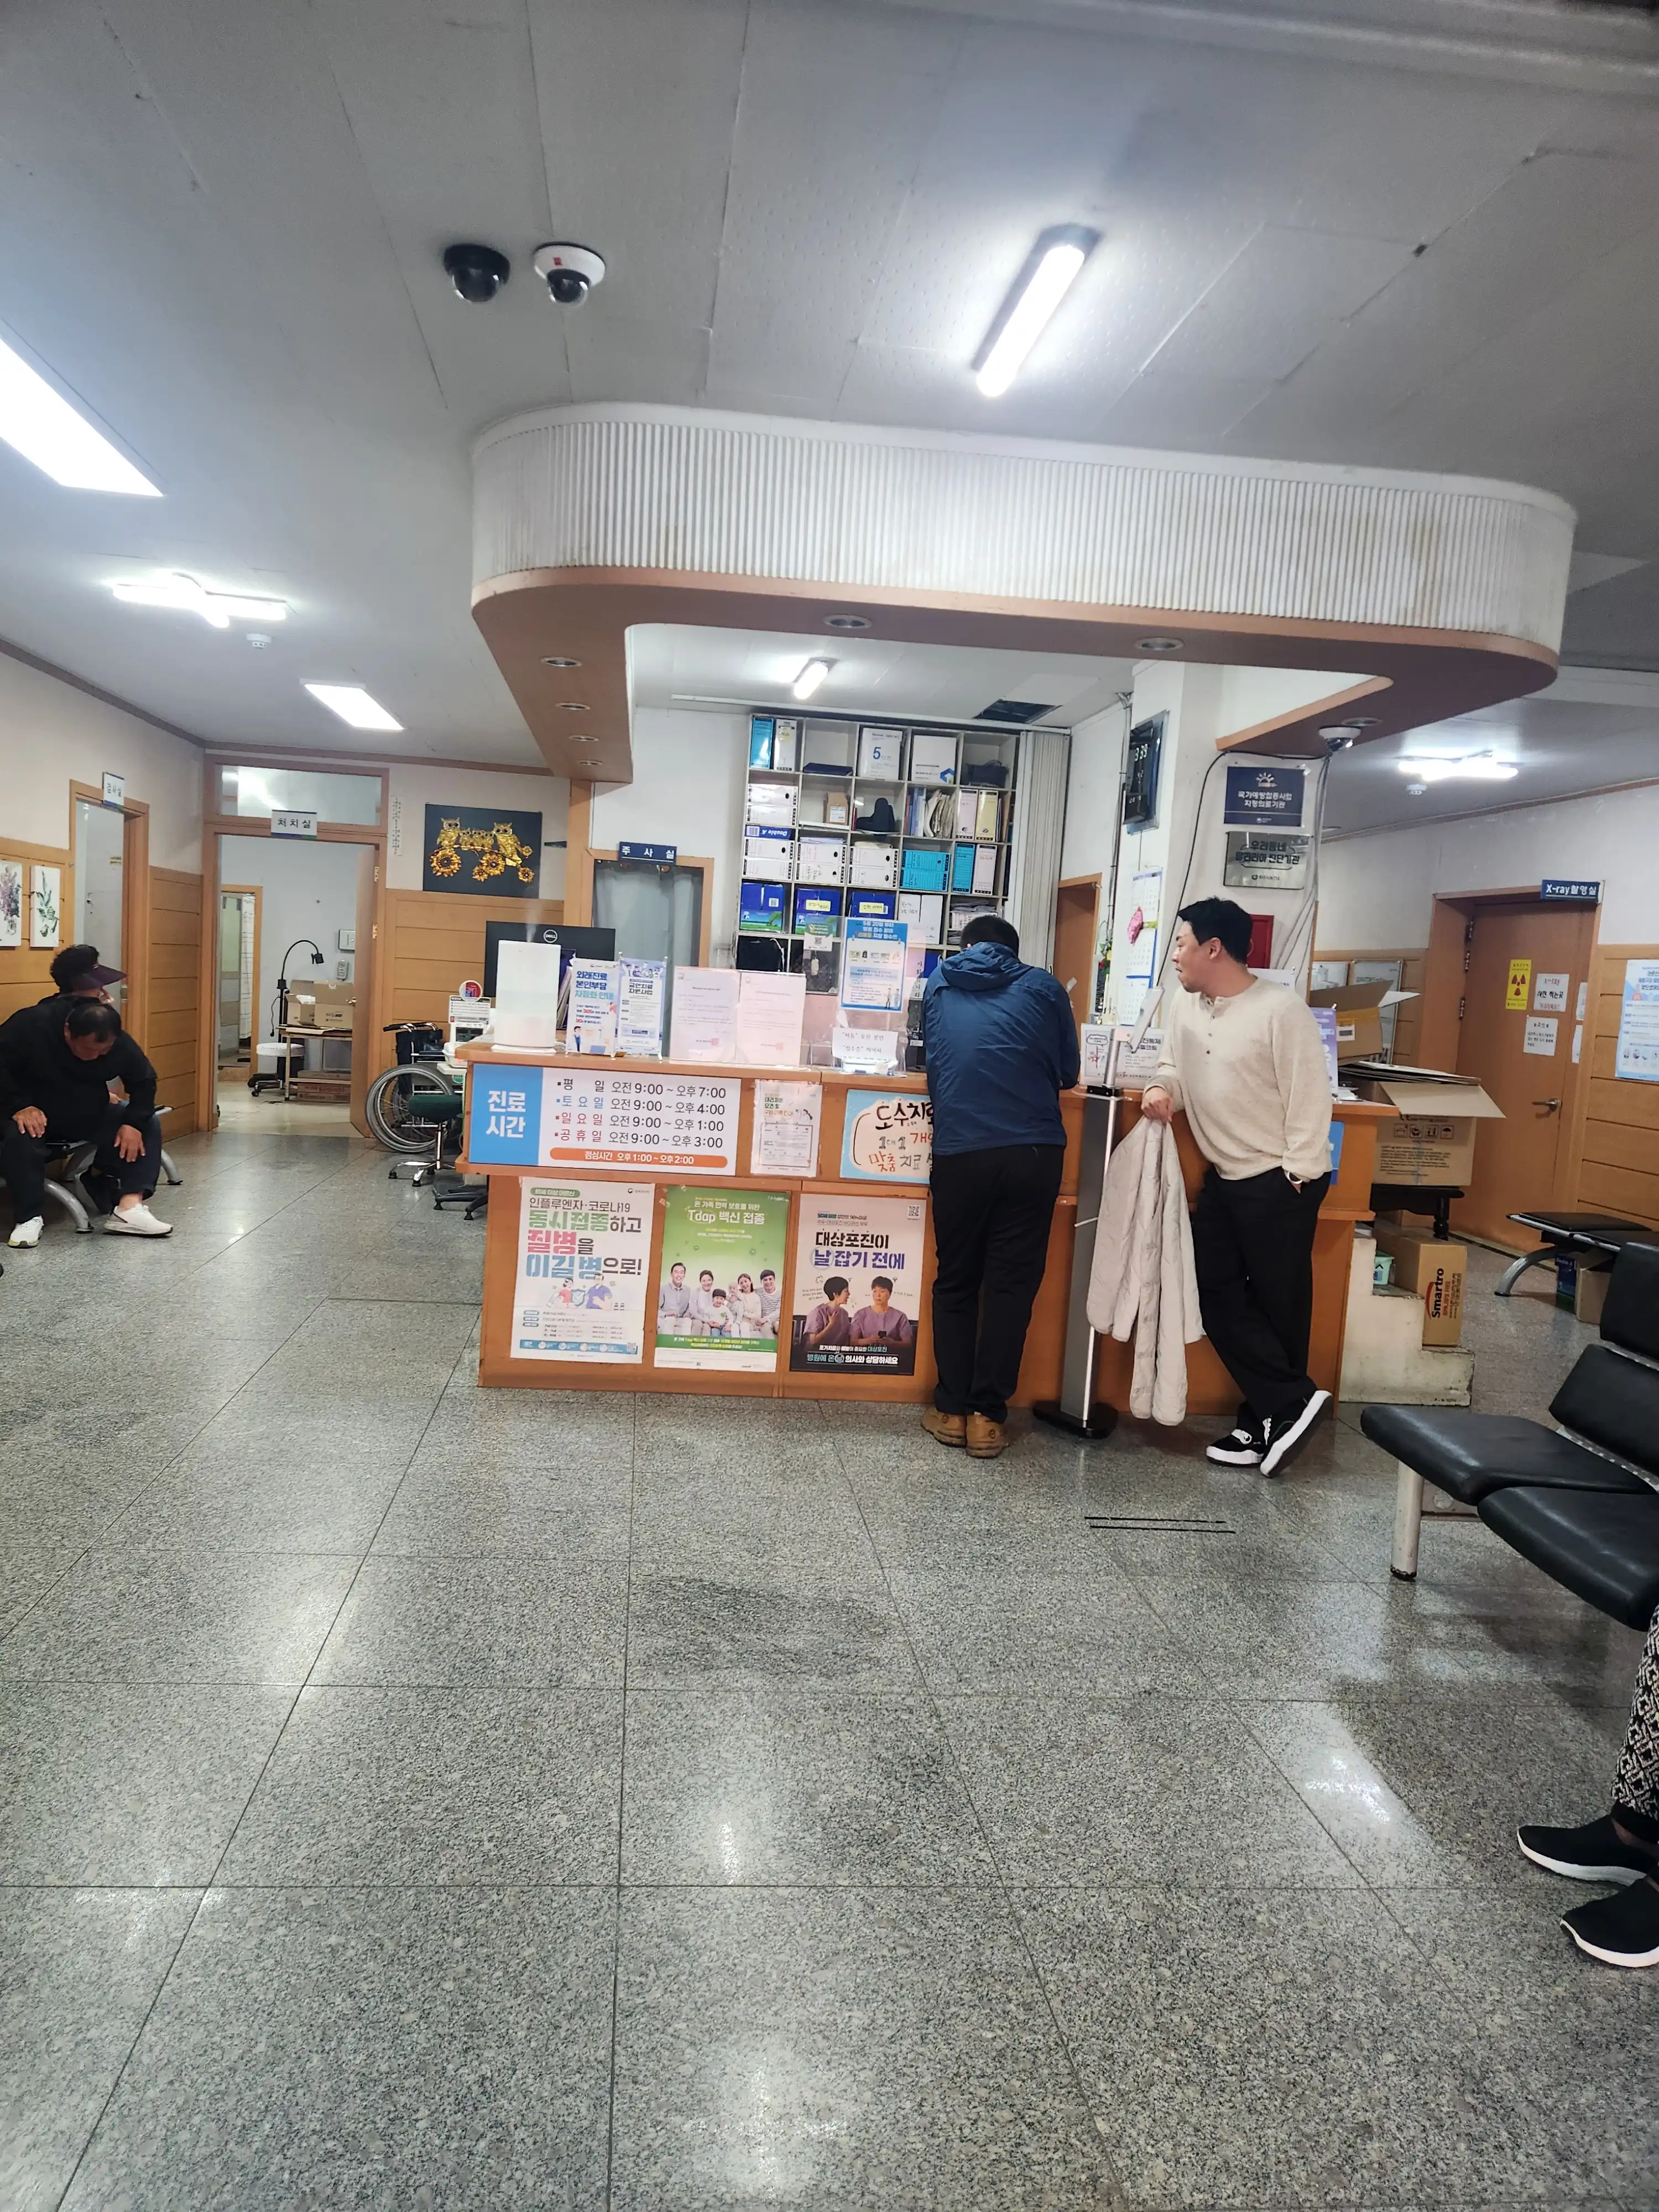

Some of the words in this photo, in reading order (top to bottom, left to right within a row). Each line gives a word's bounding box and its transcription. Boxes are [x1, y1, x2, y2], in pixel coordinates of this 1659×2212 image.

[873, 747, 881, 760] 5
[277, 818, 311, 829] 처치실
[622, 845, 675, 859] 주사실
[576, 971, 608, 980] 외래진료
[576, 980, 607, 990] 본인부담
[612, 1082, 632, 1094] 오전
[634, 1083, 664, 1095] 9:00
[676, 1085, 696, 1098] 오후
[698, 1087, 726, 1099] 7:00
[487, 1090, 526, 1113] 진료
[611, 1098, 631, 1111] 오전
[633, 1099, 662, 1112] 9:00
[675, 1102, 695, 1114] 오후
[697, 1103, 725, 1115] 4:00
[486, 1115, 526, 1138] 시간
[609, 1115, 630, 1128] 오전
[632, 1116, 661, 1129] 9:00
[674, 1118, 695, 1131] 오후
[697, 1120, 724, 1132] 1:00
[608, 1131, 629, 1144] 오전
[631, 1133, 660, 1145] 9:00
[671, 1135, 692, 1147] 오후
[694, 1136, 723, 1149] 3:00
[585, 1151, 613, 1161] 점심시간
[617, 1152, 632, 1161] 오후
[633, 1153, 653, 1162] 1:00
[674, 1155, 695, 1165] 2:00
[868, 1150, 896, 1172] 맞춤
[899, 1154, 922, 1170] 치료
[529, 1209, 641, 1233] 동시접종하고
[687, 1209, 716, 1224] Tdap
[719, 1211, 740, 1224] 백신
[743, 1212, 765, 1225] 접종
[528, 1230, 594, 1255] 질병을
[815, 1230, 889, 1250] 대상포진이
[814, 1249, 832, 1267] 날
[834, 1250, 868, 1268] 잡기
[871, 1251, 905, 1270] 전에
[1431, 1268, 1444, 1318] Smartro
[807, 1354, 827, 1362] 병원에
[845, 1355, 865, 1364] 의사와
[865, 1355, 899, 1365] 상담하세요
